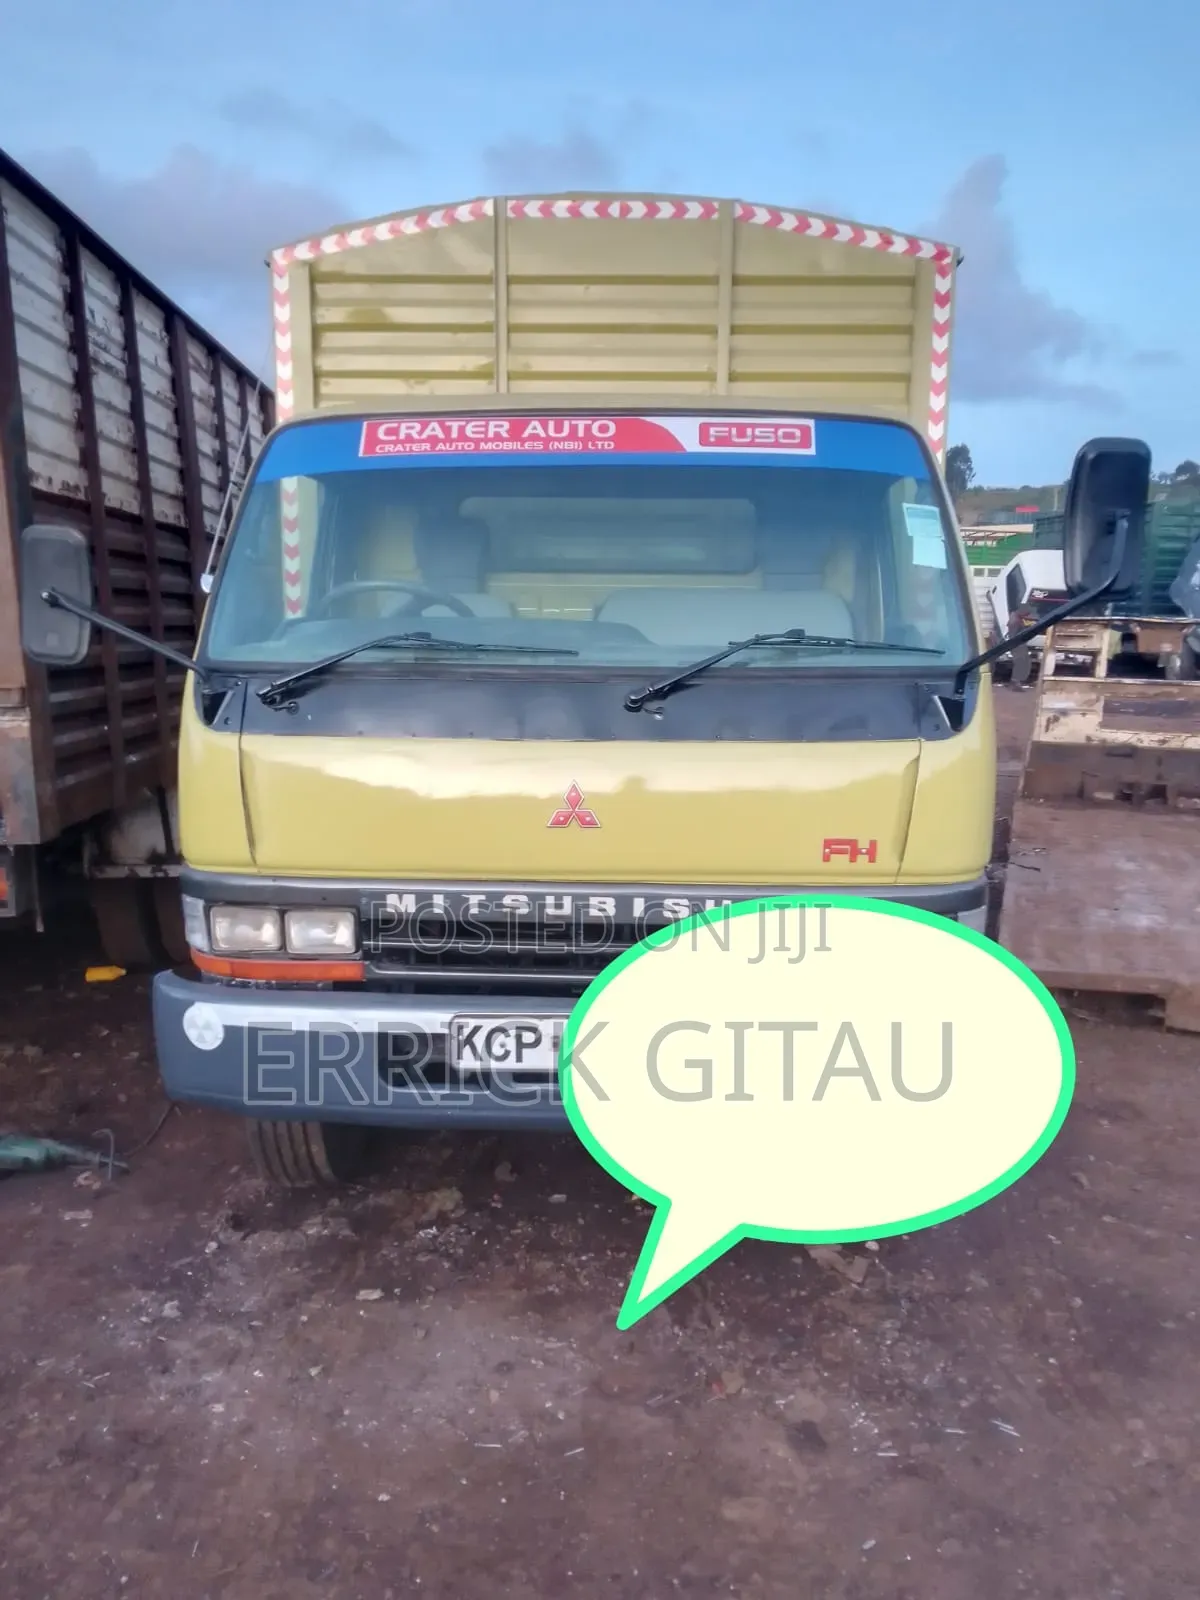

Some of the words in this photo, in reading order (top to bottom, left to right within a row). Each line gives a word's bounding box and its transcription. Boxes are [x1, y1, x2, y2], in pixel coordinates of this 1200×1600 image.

[377, 420, 509, 440] CRATER
[521, 419, 617, 438] AUTO
[707, 425, 802, 444] FUSO
[375, 442, 431, 453] CRATER
[434, 441, 475, 451] AUTO
[480, 440, 543, 450] MOBILES
[549, 440, 583, 451] (NBI)
[588, 440, 615, 450] LTD
[456, 1024, 543, 1064] KCP
